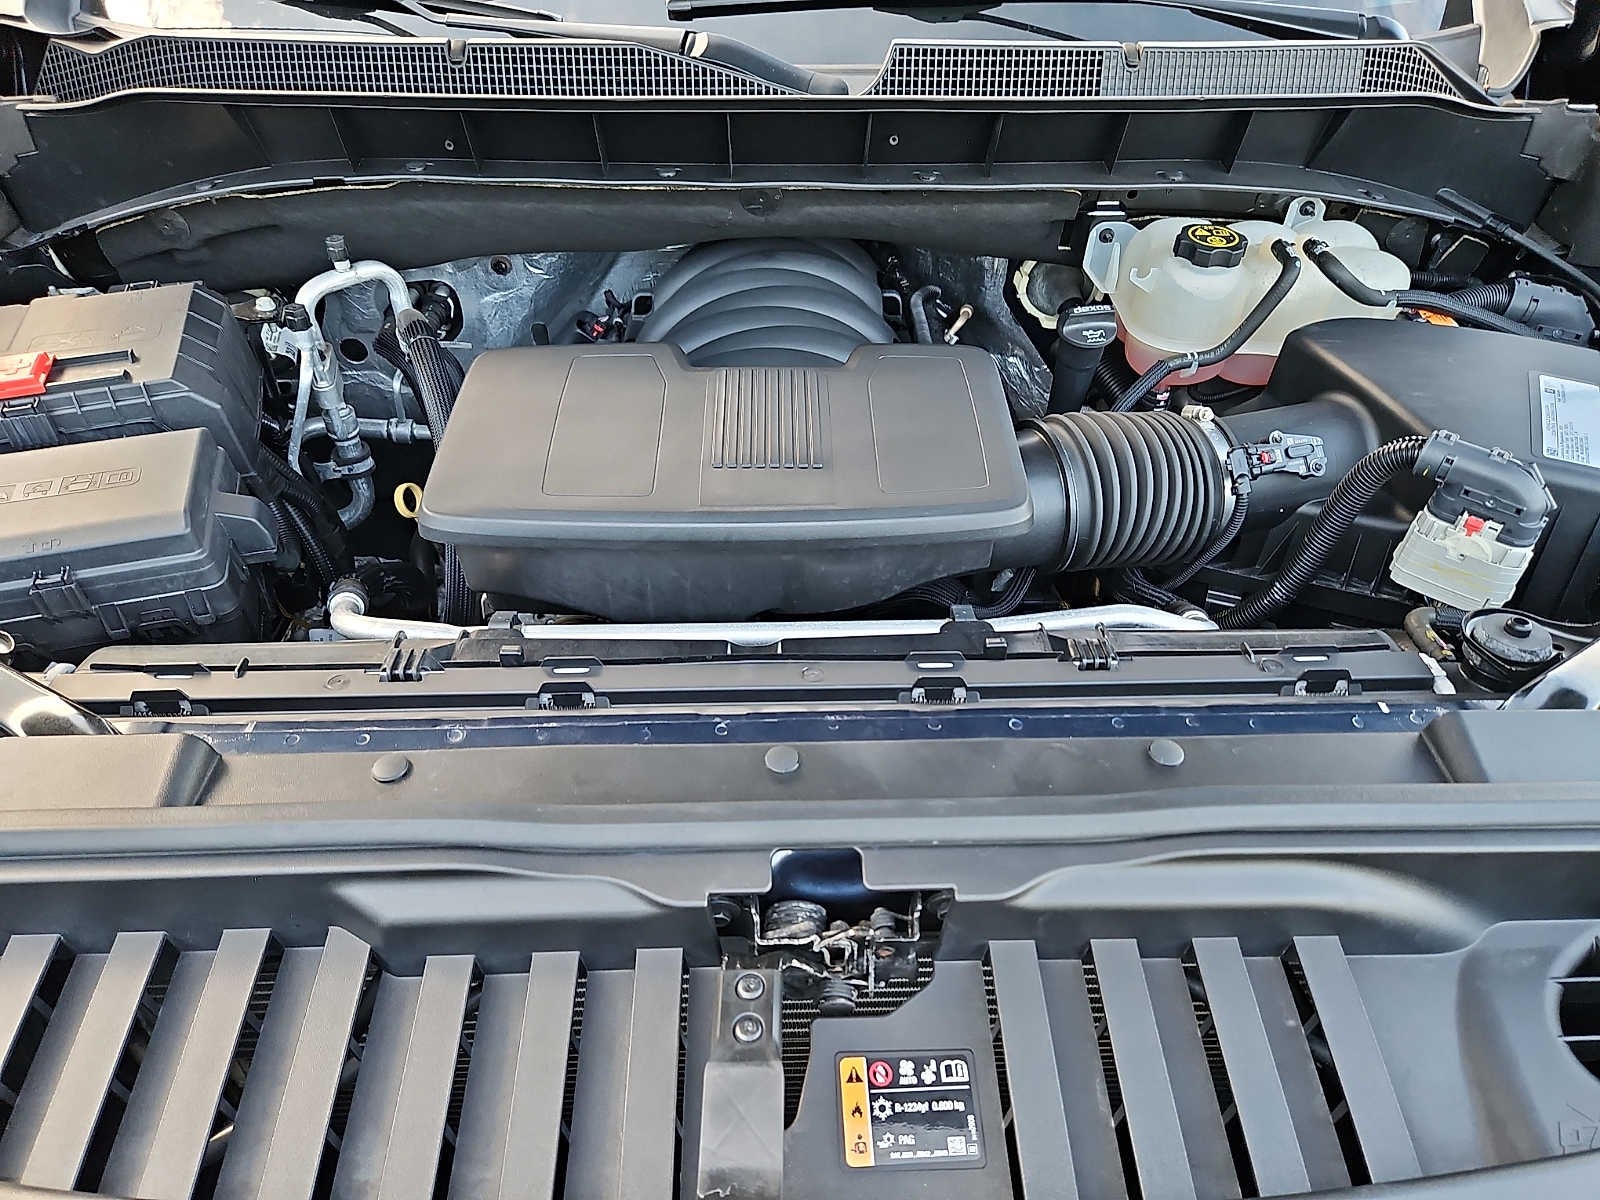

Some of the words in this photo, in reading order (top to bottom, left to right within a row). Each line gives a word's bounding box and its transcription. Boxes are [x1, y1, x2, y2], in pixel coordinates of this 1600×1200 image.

[1074, 305, 1111, 313] dexos
[899, 1075, 918, 1085] AUTO
[954, 1100, 966, 1111] kg
[898, 1134, 916, 1145] PAG
